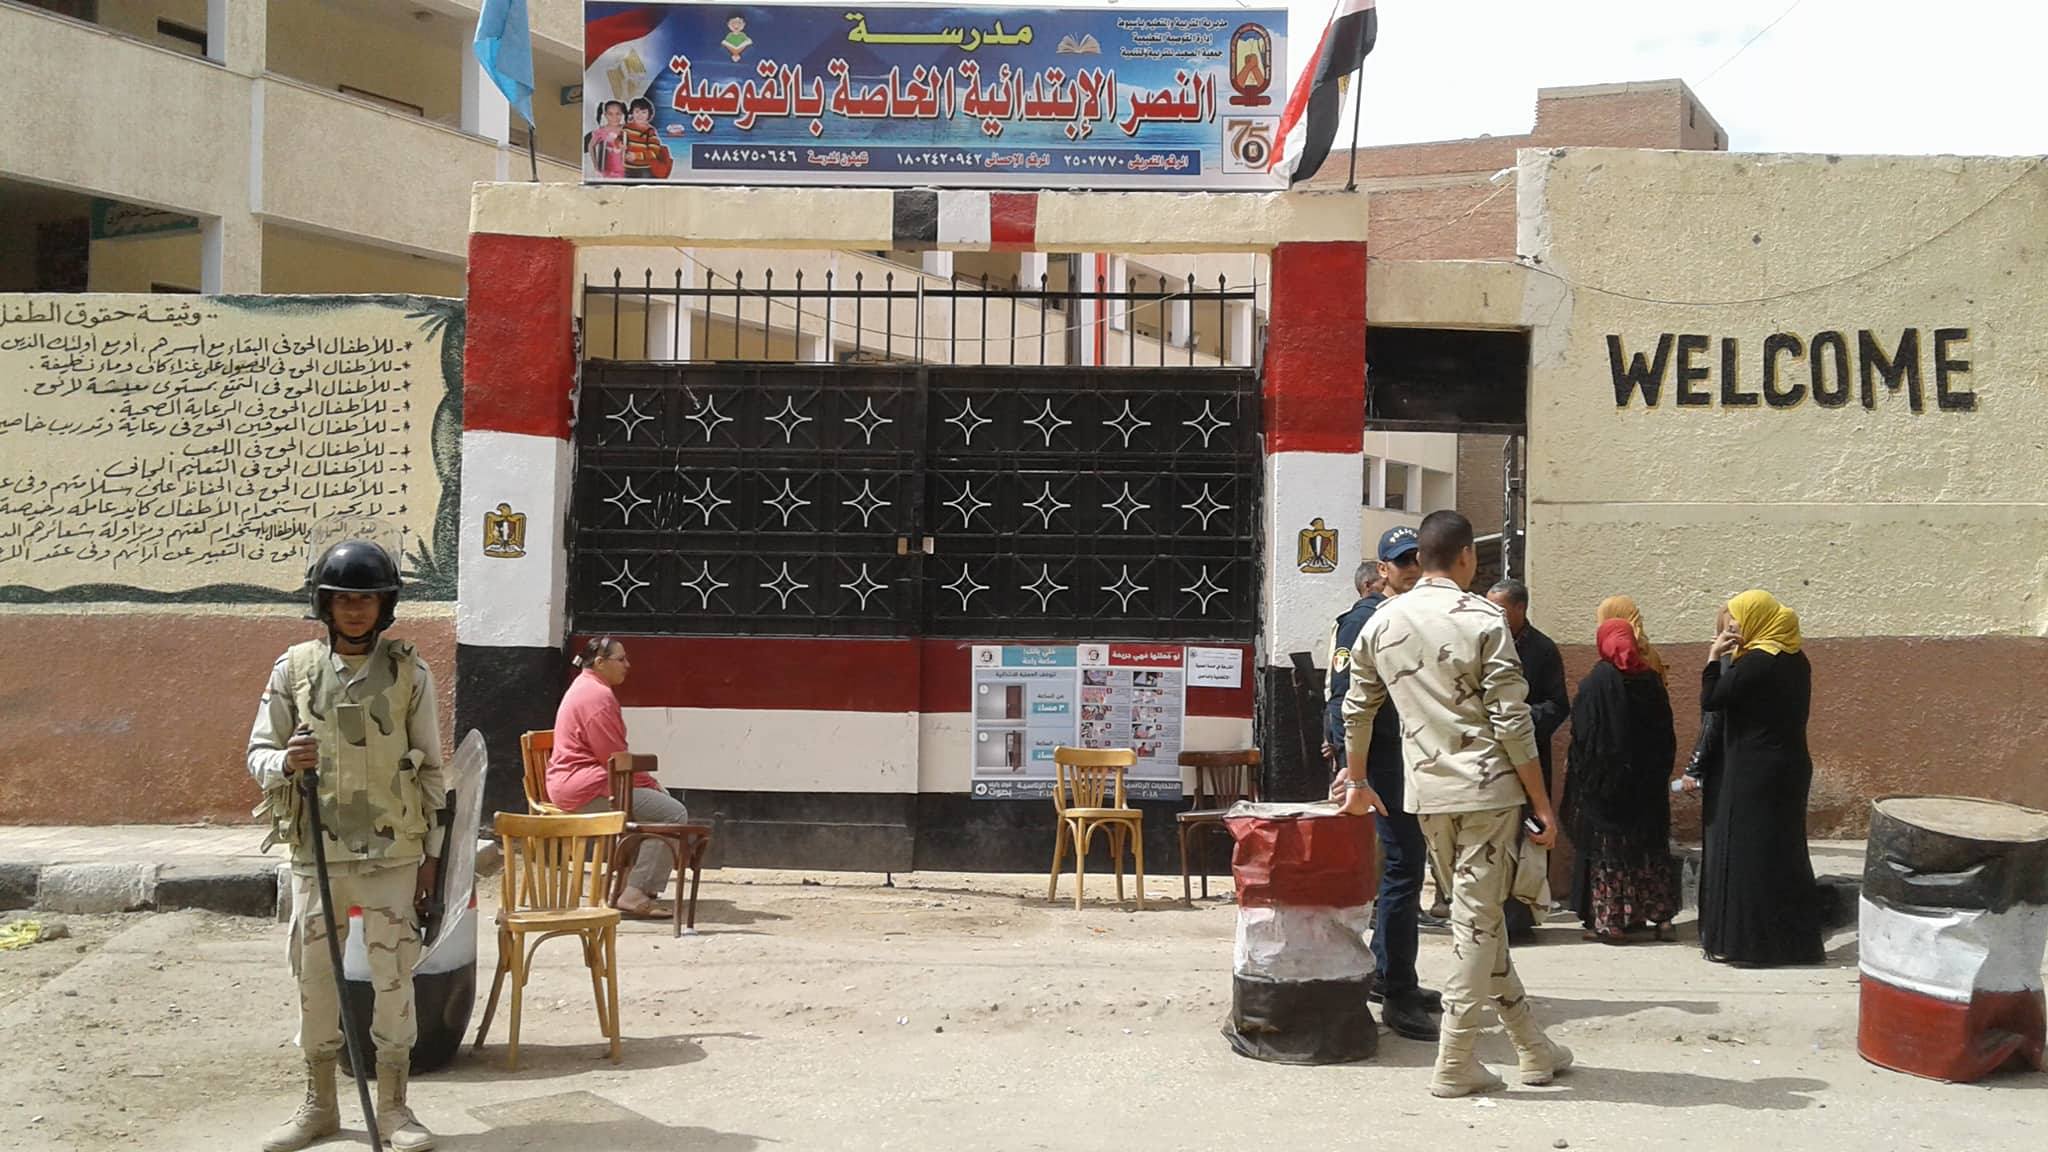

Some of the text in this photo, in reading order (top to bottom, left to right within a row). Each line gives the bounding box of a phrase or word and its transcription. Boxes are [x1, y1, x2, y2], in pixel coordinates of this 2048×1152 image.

[844, 11, 1034, 51] مدرسة
[669, 54, 1217, 140] النصر الإبتدائية الخاصة بالقوصية
[703, 149, 798, 163] ٠٨٨٤٧٥٠٦٤٦
[896, 152, 982, 166] ١٨٠٢٤٢٠٩٤٢
[1025, 152, 1051, 169] الرقم
[1063, 154, 1125, 168] ٢٥٠٢٧٧٠
[1164, 153, 1189, 170] الرقم
[0, 301, 201, 329] وثيقة حقوق الطفل
[1, 333, 44, 350] الذين
[46, 333, 97, 354] أولئك
[100, 340, 121, 356] مع
[206, 342, 224, 358] مع
[227, 337, 268, 356] البقاء
[292, 335, 322, 355] الحق
[324, 335, 394, 357] للأطفال
[170, 358, 201, 376] غذاء
[222, 355, 269, 379] الحصول
[288, 357, 319, 379] الحق
[322, 358, 392, 376] للأطفال
[1606, 328, 1979, 414] WELCOME
[86, 377, 149, 397] معيشة
[152, 378, 217, 399] بمستوى
[219, 375, 258, 400] التمتع
[284, 378, 319, 399] الحق
[320, 375, 390, 397] للأطفال
[185, 398, 242, 419] الرعاية
[269, 399, 305, 419] الحق
[308, 397, 386, 418] للأطفال
[48, 417, 113, 438] وتدريب
[118, 418, 166, 437] رعاية
[192, 418, 231, 437] الحق
[308, 416, 386, 437] للأطفال
[265, 436, 302, 460] الحق
[306, 438, 384, 460] للأطفال
[177, 458, 236, 482] التعليم
[263, 457, 297, 479] الحق
[301, 459, 383, 479] للأطفال
[51, 475, 132, 504] سلامتهم
[179, 476, 231, 497] الحفاظ
[259, 476, 297, 502] الحق
[300, 479, 383, 500] للأطفال
[154, 496, 238, 518] الأطفال
[241, 500, 317, 522] استخدام
[320, 502, 363, 519] يجوز
[365, 502, 382, 516] لا
[23, 520, 95, 547] شعائرهم
[98, 520, 163, 545] ومزاولة
[167, 520, 206, 548] لغتهم
[265, 517, 306, 541] للأطفال
[33, 543, 75, 563] عقد
[162, 546, 195, 561] عن
[185, 542, 244, 566] التعبير
[269, 545, 303, 563] الحق
